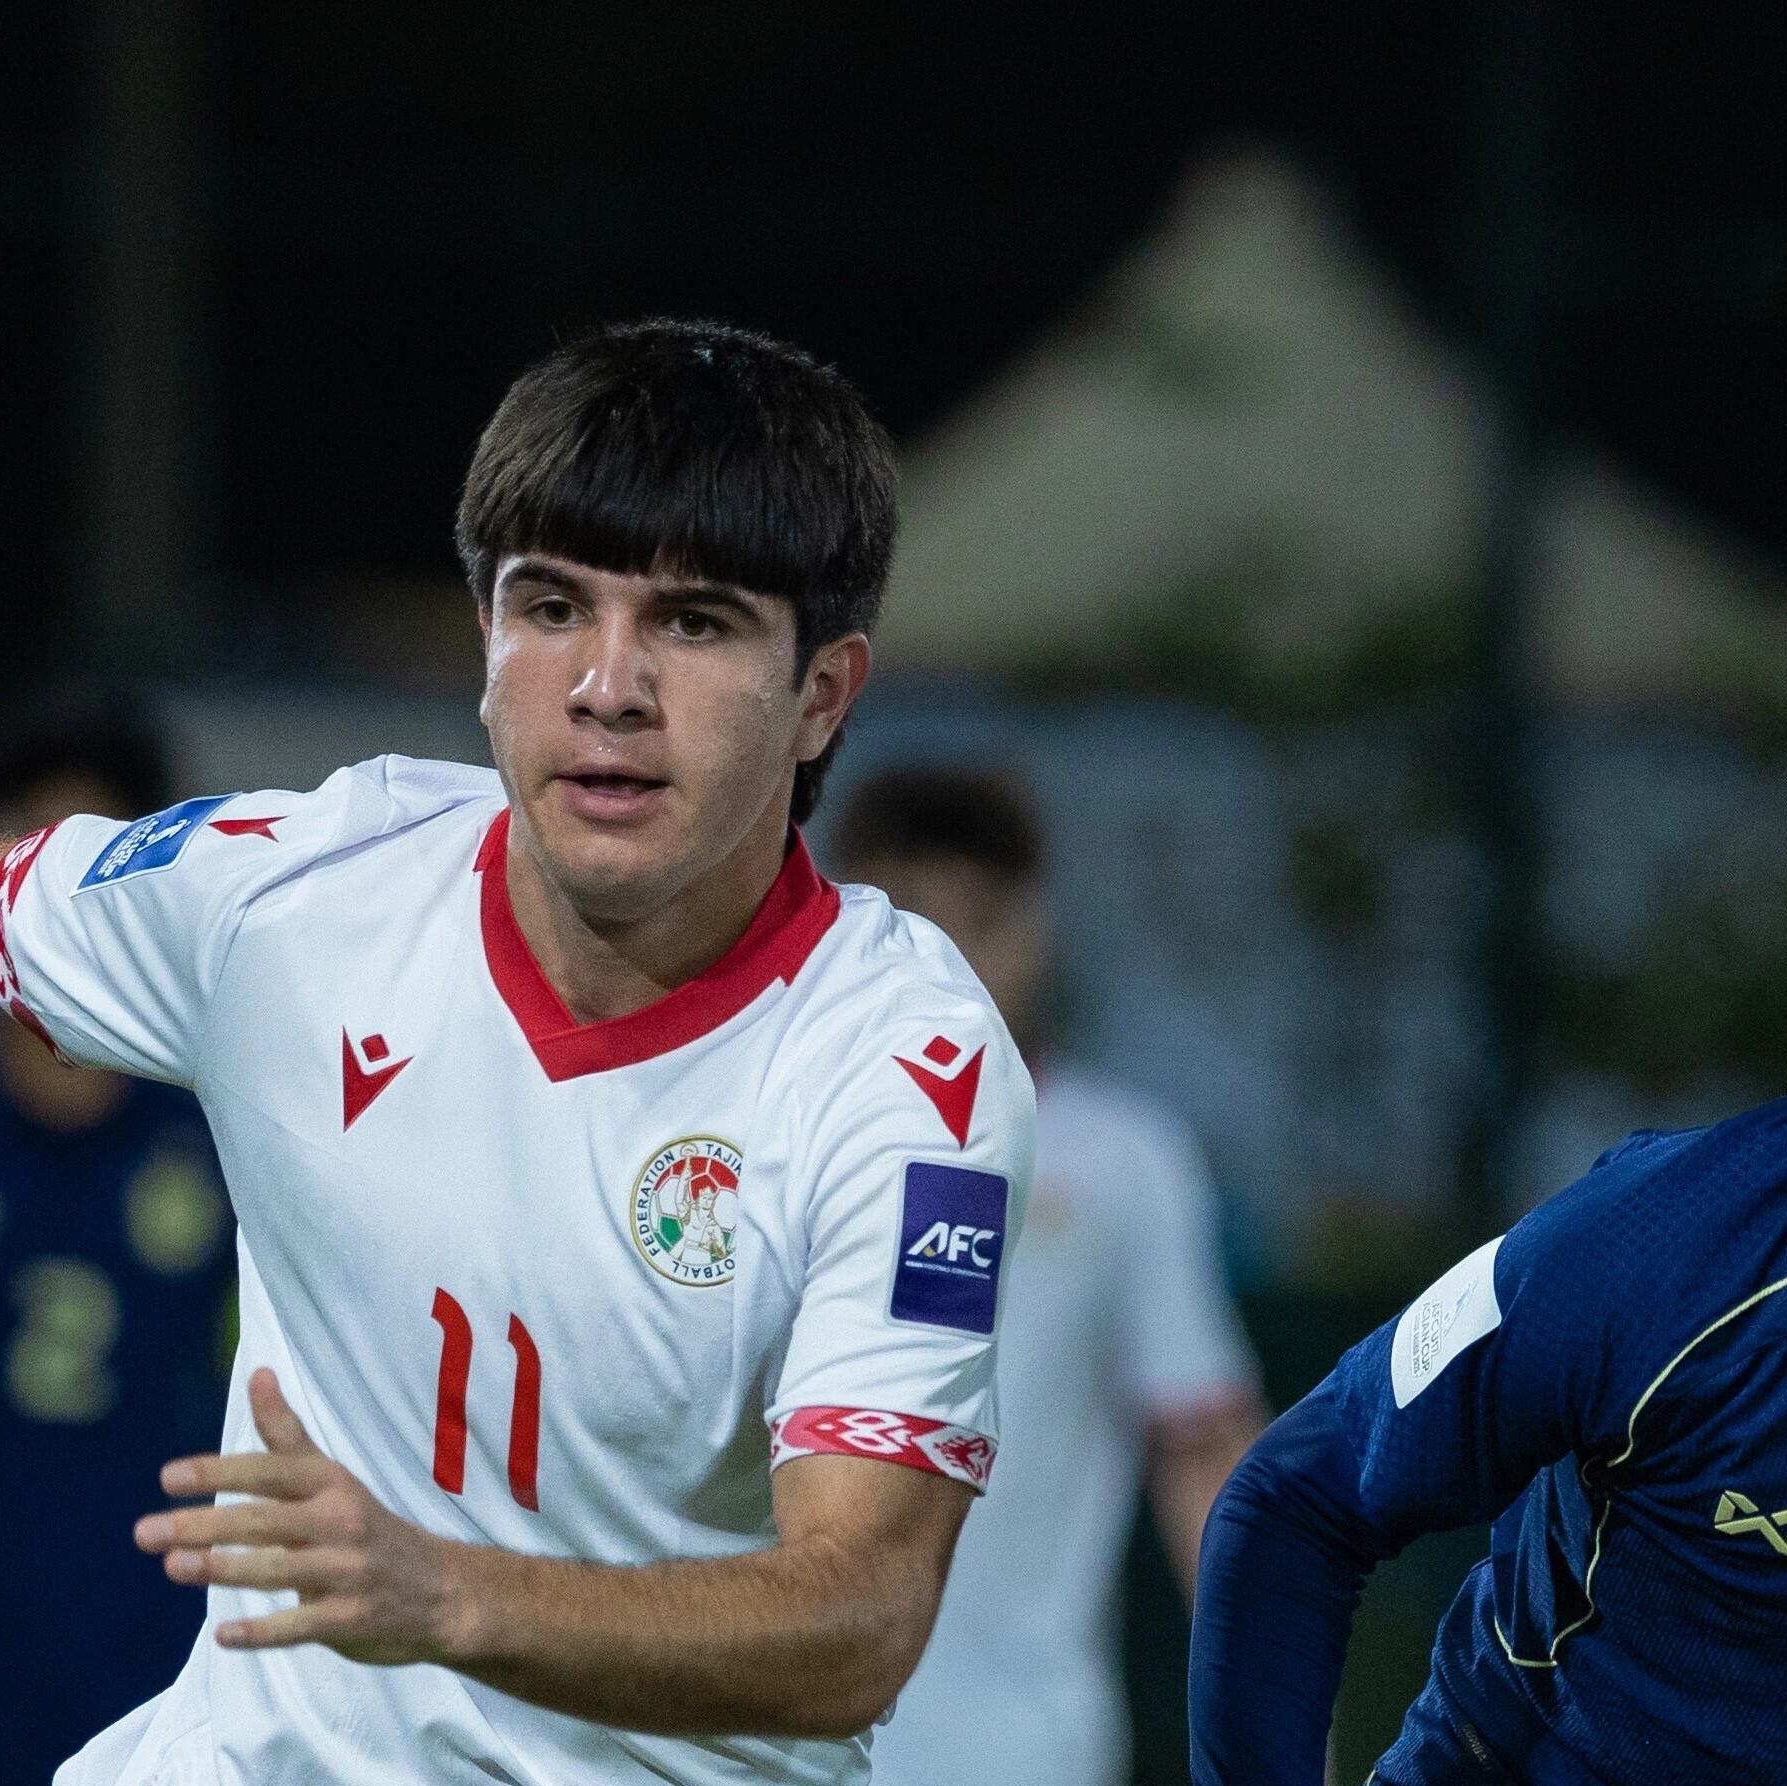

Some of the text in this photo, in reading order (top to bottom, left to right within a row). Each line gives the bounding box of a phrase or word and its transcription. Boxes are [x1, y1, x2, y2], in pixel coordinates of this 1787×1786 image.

[637, 1150, 675, 1257] FEDERATION
[671, 1258, 735, 1278] OTBALL
[907, 1221, 997, 1268] AFC
[430, 1286, 542, 1513] 11
